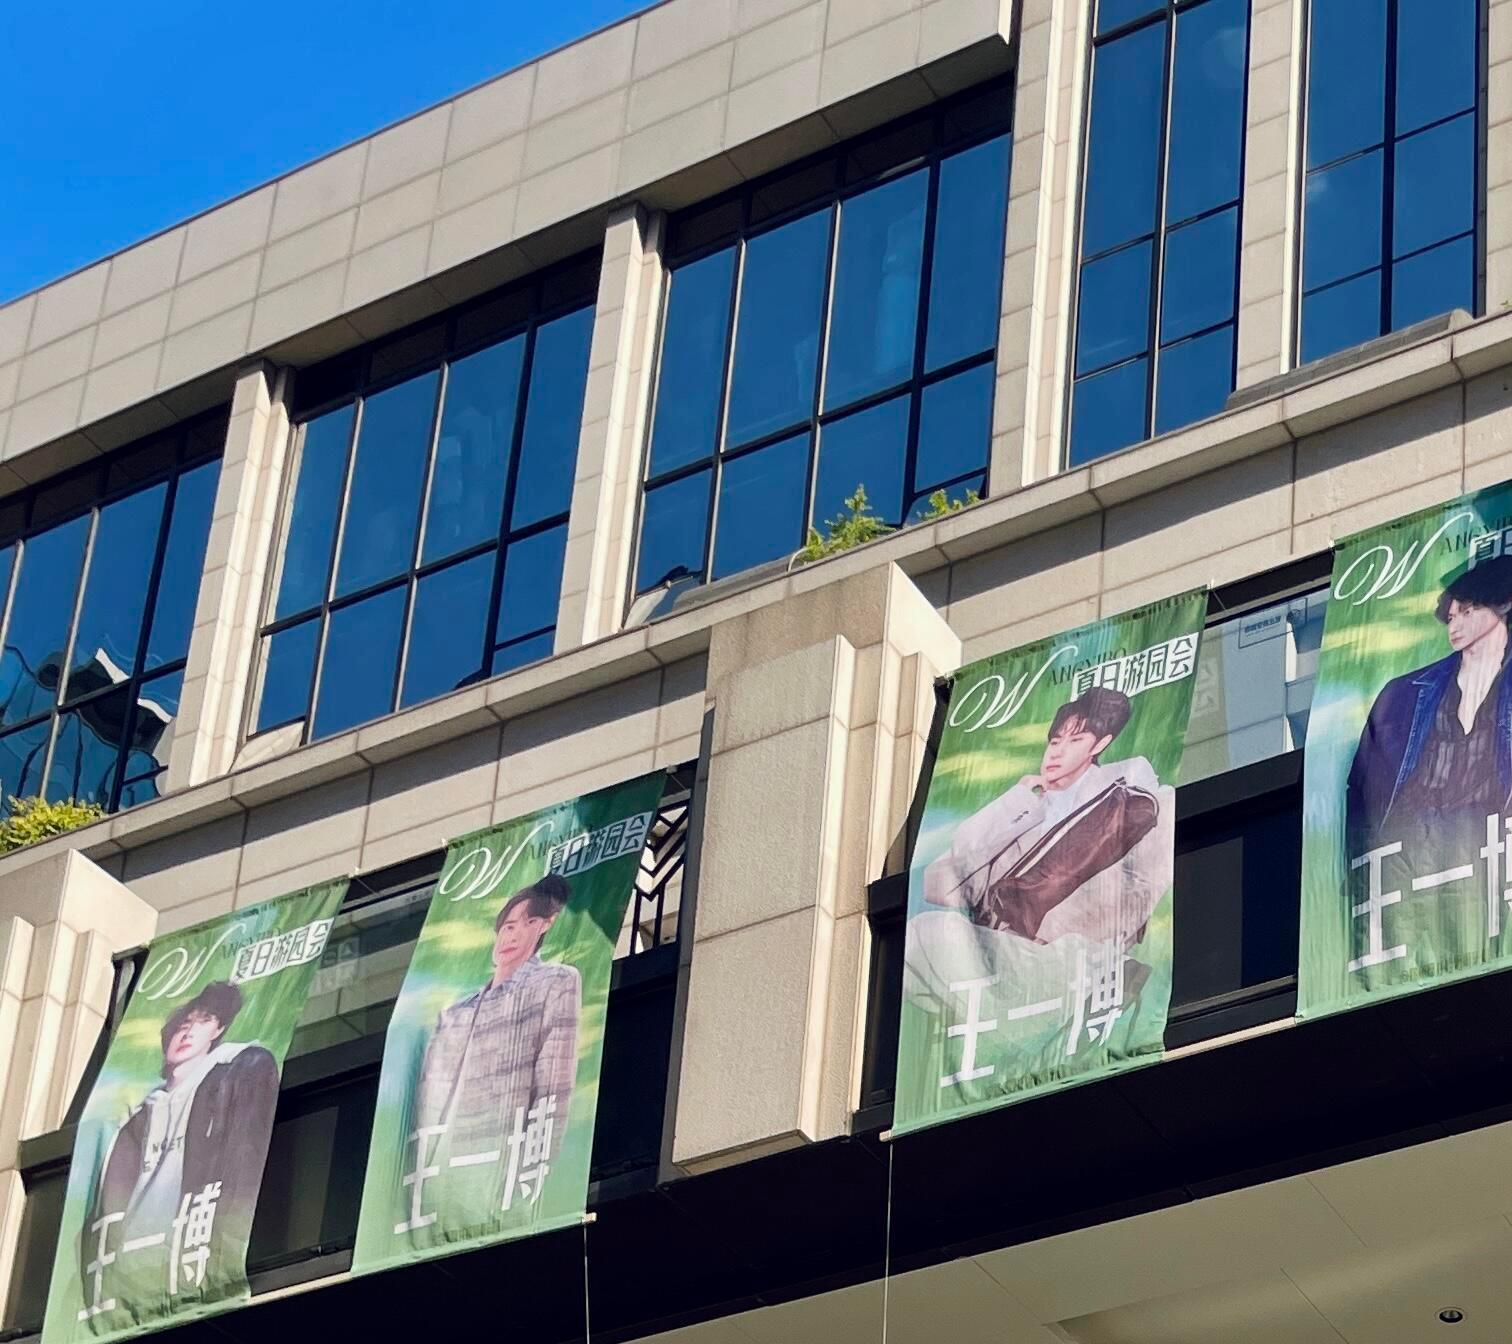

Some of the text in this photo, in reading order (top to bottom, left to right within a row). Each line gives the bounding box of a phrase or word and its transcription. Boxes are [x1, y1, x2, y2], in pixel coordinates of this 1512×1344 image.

[940, 936, 1125, 1088] 王一博
[394, 1095, 556, 1234] 王一博
[78, 1181, 222, 1322] 王一博
